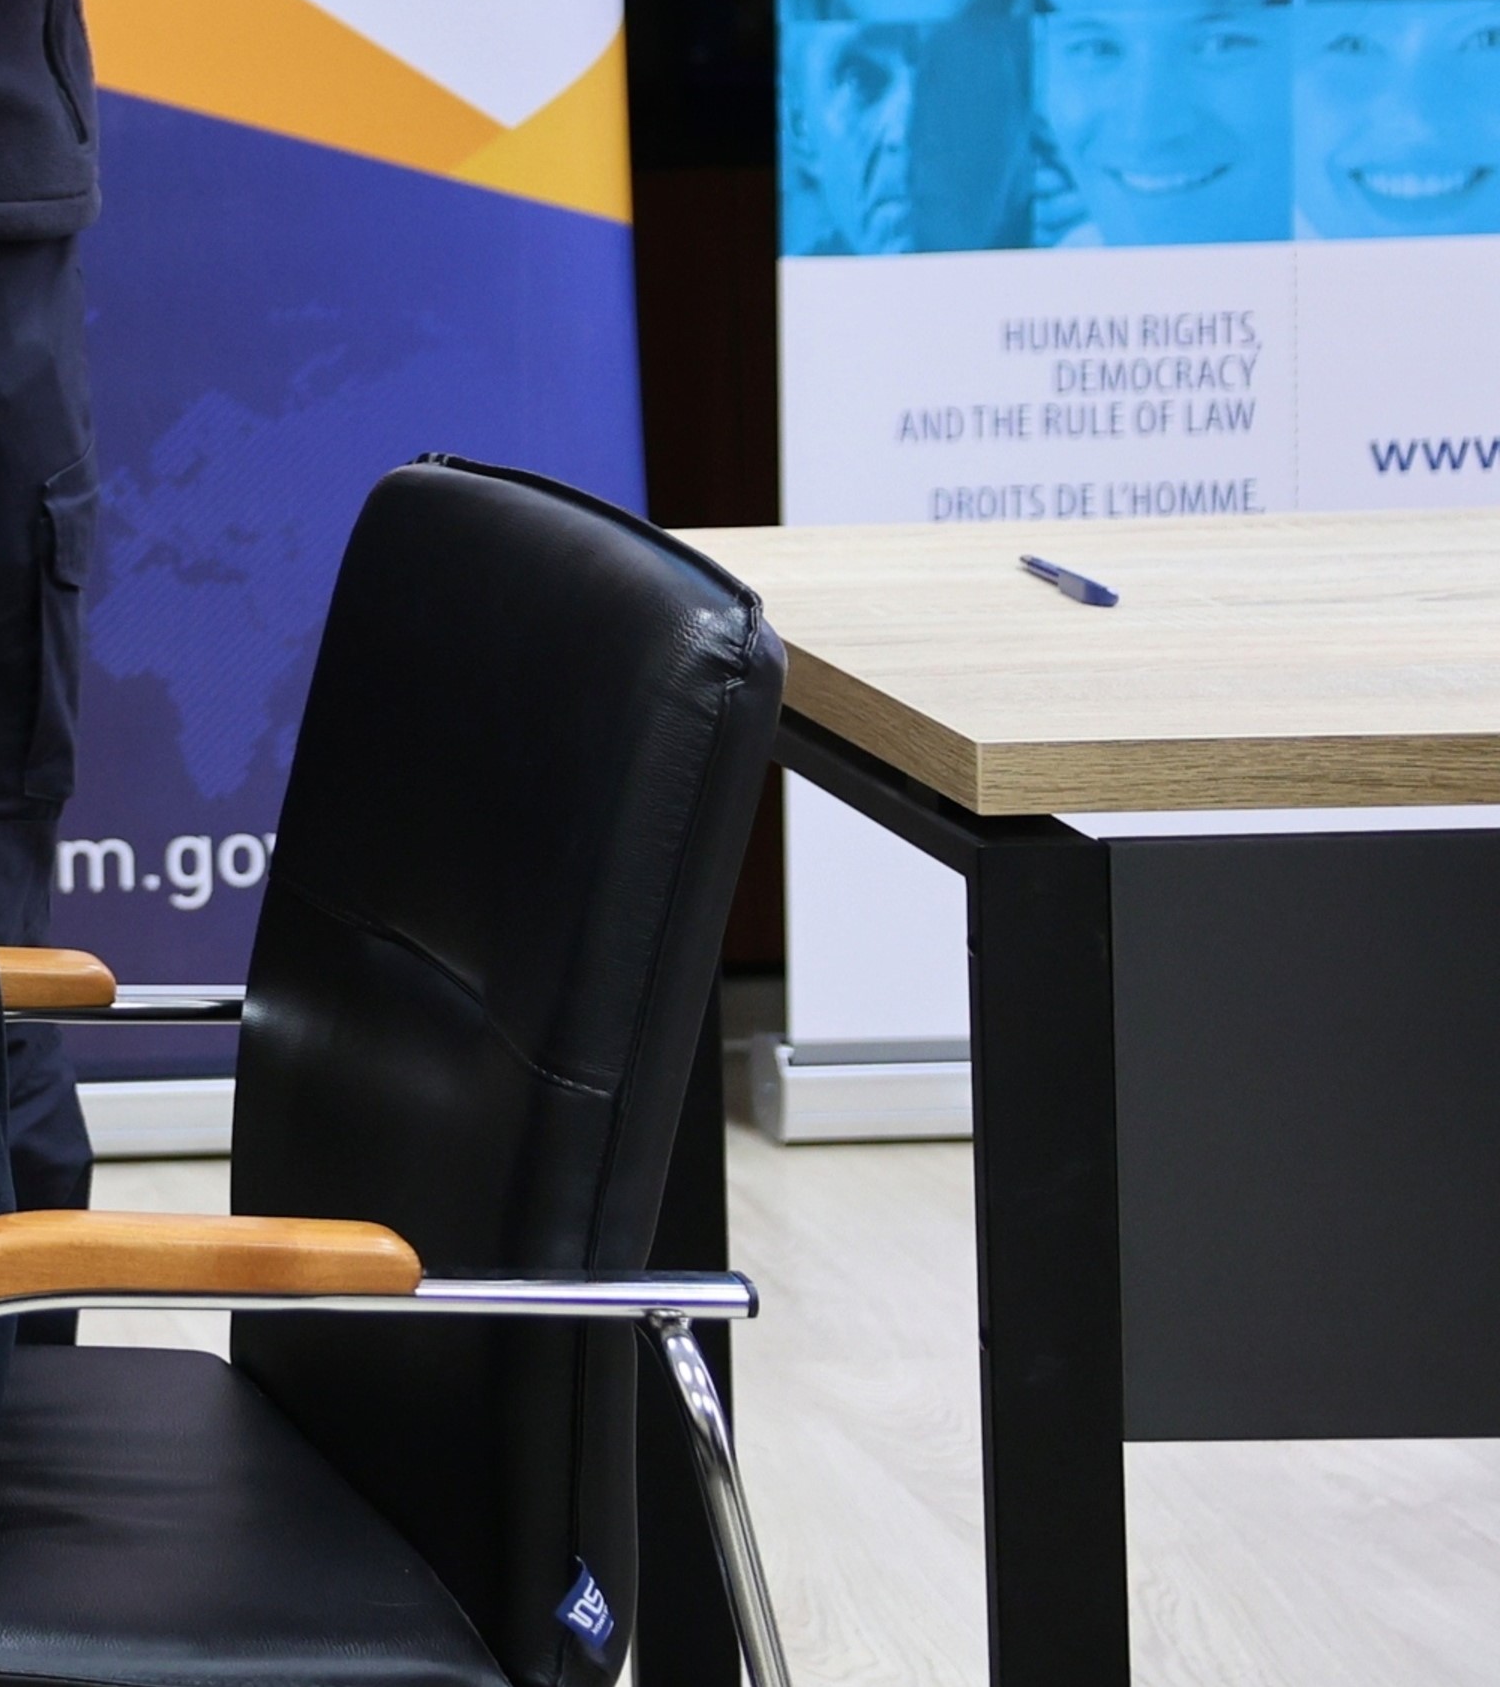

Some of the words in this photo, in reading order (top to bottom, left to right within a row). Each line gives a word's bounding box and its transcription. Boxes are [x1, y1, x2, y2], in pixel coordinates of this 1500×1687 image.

[1004, 315, 1130, 352] HUMAN
[1141, 310, 1263, 351] RIGHTS,
[1055, 352, 1260, 395] DEMOCRACY
[898, 406, 965, 443] AND
[971, 403, 1034, 440] THE
[1043, 401, 1125, 437] RULE
[1135, 399, 1175, 435] OF
[1185, 397, 1257, 433] LAW
[931, 483, 1047, 522] DROITS
[1056, 482, 1097, 520] DE
[55, 832, 277, 911] m.go
